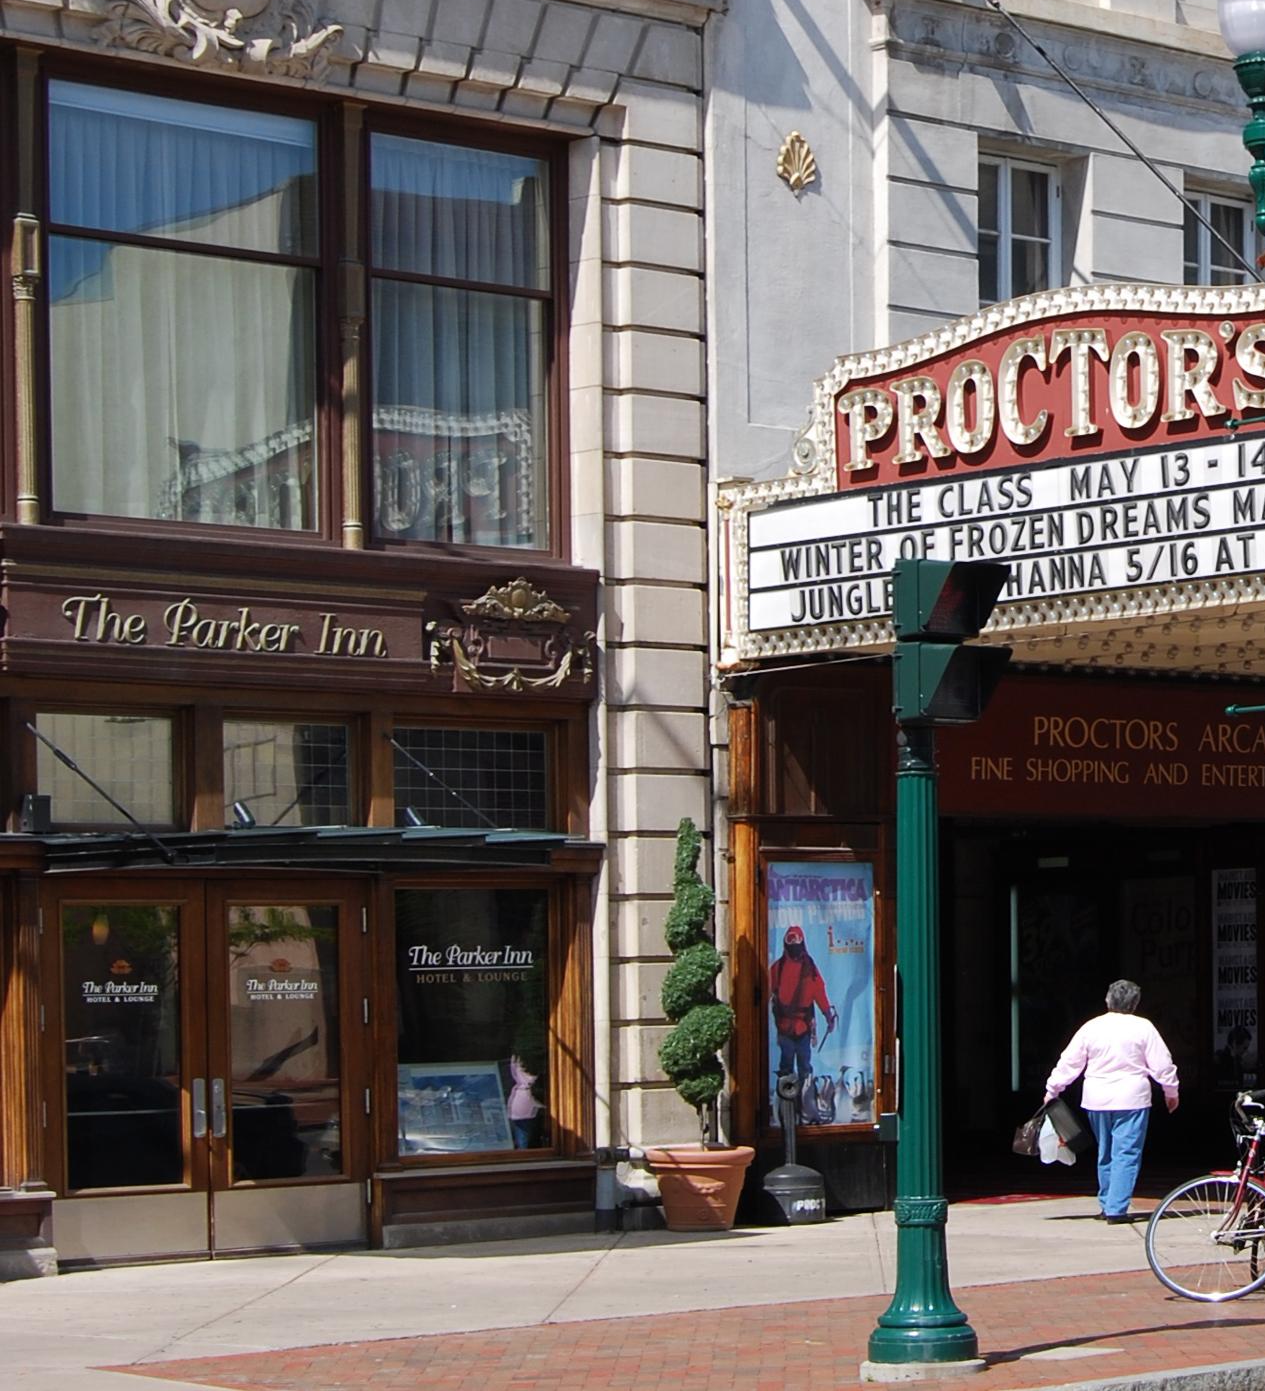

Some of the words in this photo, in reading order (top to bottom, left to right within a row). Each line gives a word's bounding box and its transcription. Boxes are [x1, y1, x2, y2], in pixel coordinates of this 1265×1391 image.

[867, 488, 922, 528] THE
[938, 472, 1033, 519] CLASS
[1070, 458, 1140, 501] MAY
[780, 538, 884, 582] WINTER
[900, 530, 935, 559] OF
[950, 512, 1064, 561] FROZEN
[1076, 494, 1211, 544] DREAMS
[1006, 552, 1107, 596] HANNA
[1126, 540, 1199, 583] 5/16
[1215, 533, 1255, 573] AT
[62, 593, 146, 644] The
[163, 598, 300, 652] Parker
[313, 612, 387, 658] Inn
[1033, 716, 1179, 752] PROCTORS
[970, 757, 1013, 782] FINE
[1026, 757, 1130, 785] SHOPPING
[1144, 762, 1189, 786] AND
[408, 944, 442, 966] The
[445, 943, 502, 965] Parker
[503, 944, 534, 965] Inn
[82, 980, 102, 994] The
[104, 980, 139, 994] Parker
[139, 981, 158, 994] Inn
[246, 979, 266, 991] The
[267, 979, 300, 991] Parker
[300, 979, 318, 991] Inn
[416, 973, 457, 984] HOTEL
[462, 973, 471, 983] &
[478, 971, 528, 982] LOUNGE
[86, 996, 113, 1004] HOTEL
[123, 995, 155, 1003] LOUNGE
[251, 993, 275, 1001] HOTEL
[285, 992, 315, 1000] LOUNGE
